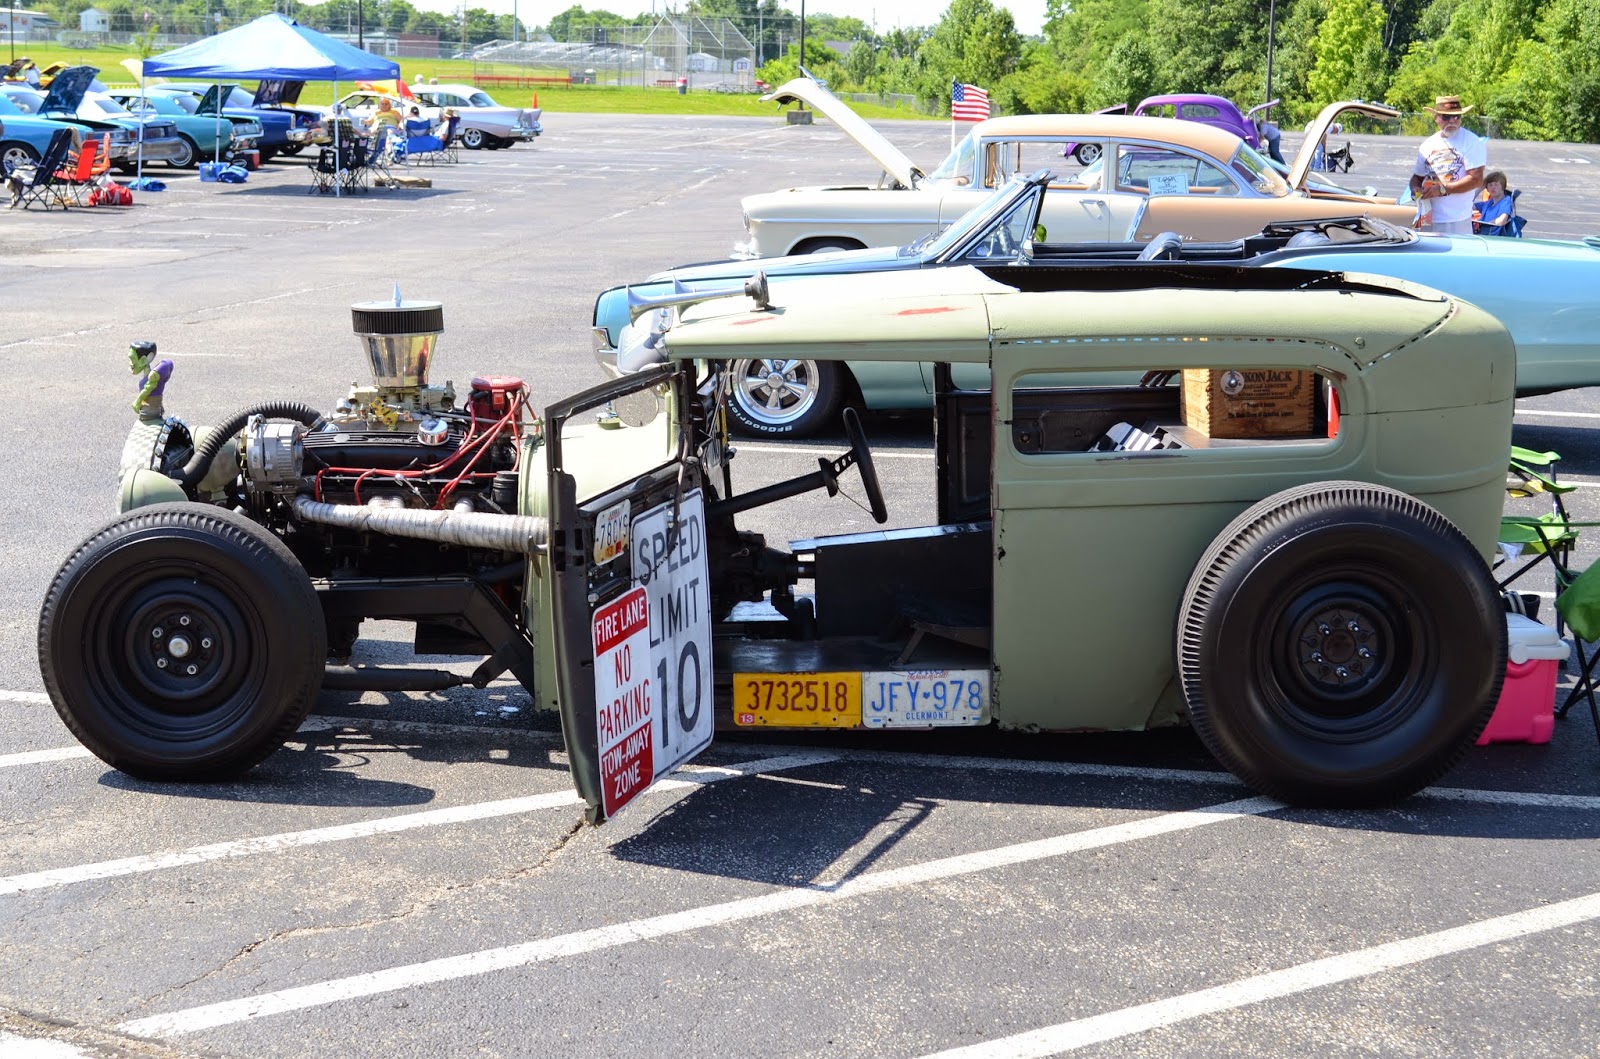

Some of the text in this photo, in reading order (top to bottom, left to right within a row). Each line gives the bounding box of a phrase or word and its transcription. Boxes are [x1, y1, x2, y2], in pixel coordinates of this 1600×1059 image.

[1266, 370, 1293, 382] JACK
[728, 400, 792, 432] BFGoodrich
[595, 596, 645, 646] FIRE LANE
[648, 577, 699, 649] LIMIT
[615, 644, 631, 688] NO
[600, 679, 650, 747] PARKING
[657, 640, 701, 748] 10
[747, 680, 848, 712] 3732518
[740, 714, 754, 723] 13
[905, 711, 949, 720] CLERMONT
[603, 725, 650, 778] TOW-AWAY
[615, 760, 641, 799] ZONE
